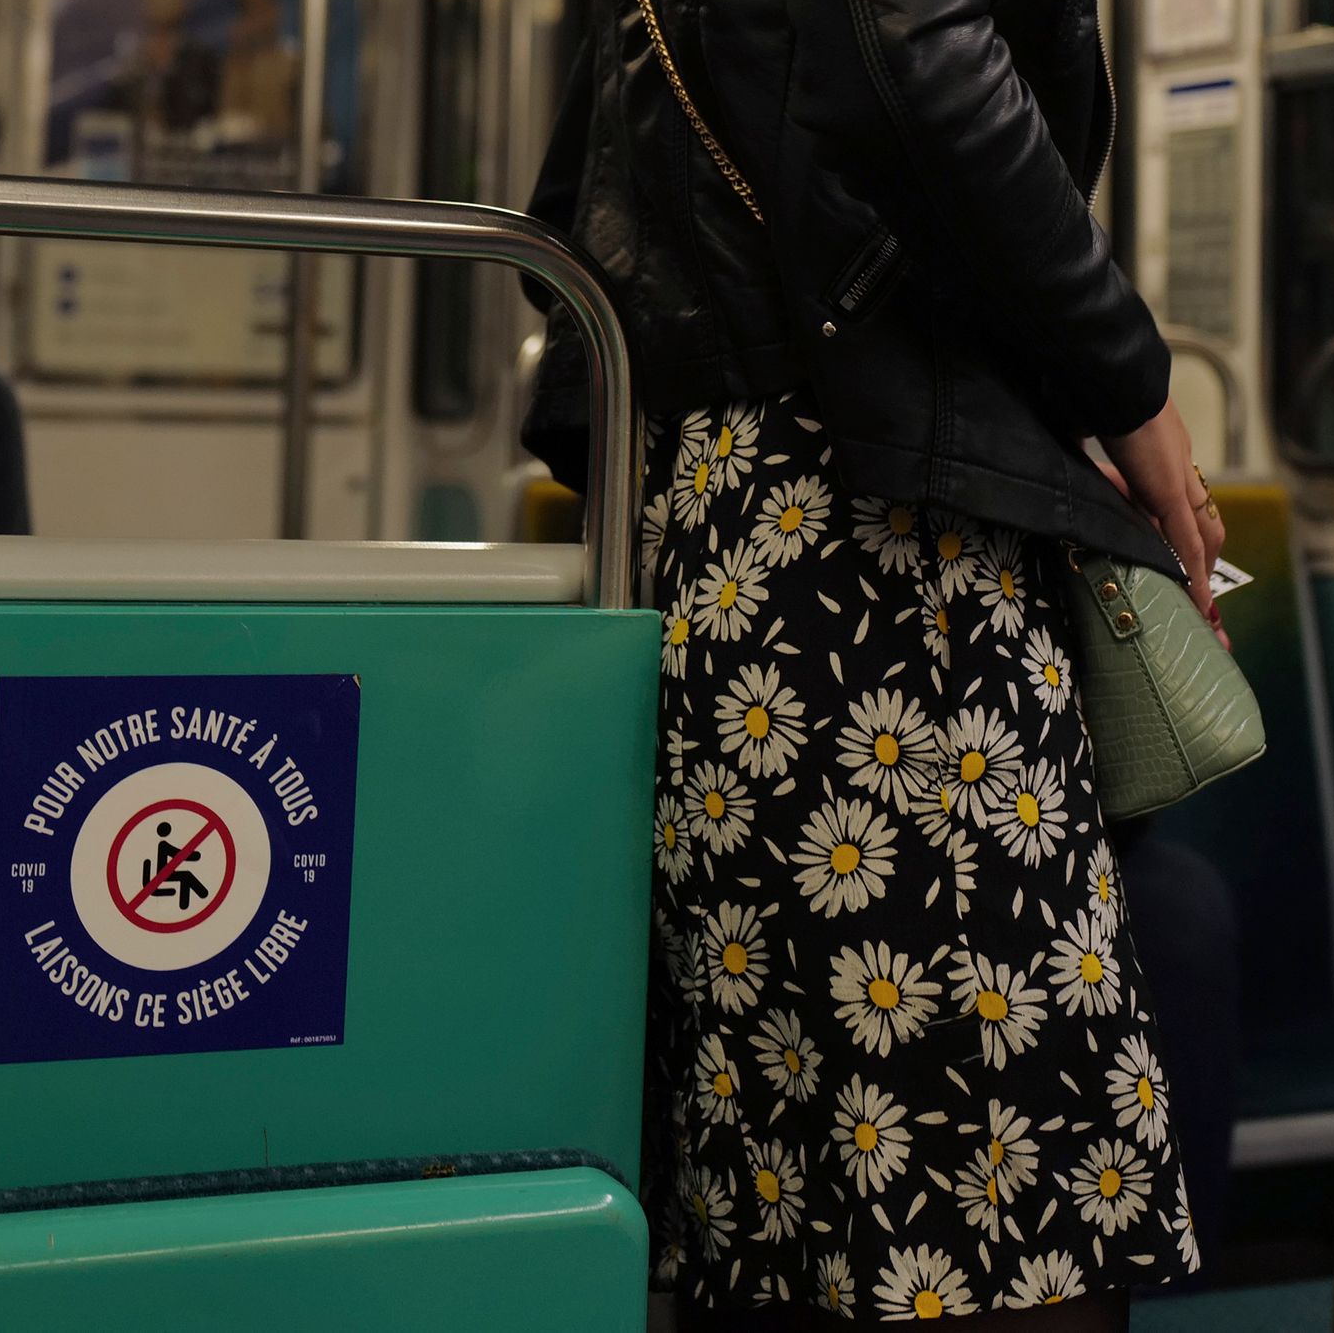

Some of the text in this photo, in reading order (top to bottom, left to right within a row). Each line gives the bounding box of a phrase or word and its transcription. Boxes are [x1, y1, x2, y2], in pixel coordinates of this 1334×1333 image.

[23, 706, 319, 837] POUR NOTRE SANTÉ À TOUS
[293, 853, 326, 869] COVID
[11, 862, 46, 878] COVID
[303, 869, 315, 884] 19
[21, 879, 34, 894] 19
[24, 908, 309, 1028] LAISSONS CE SIÈGE LIBRE
